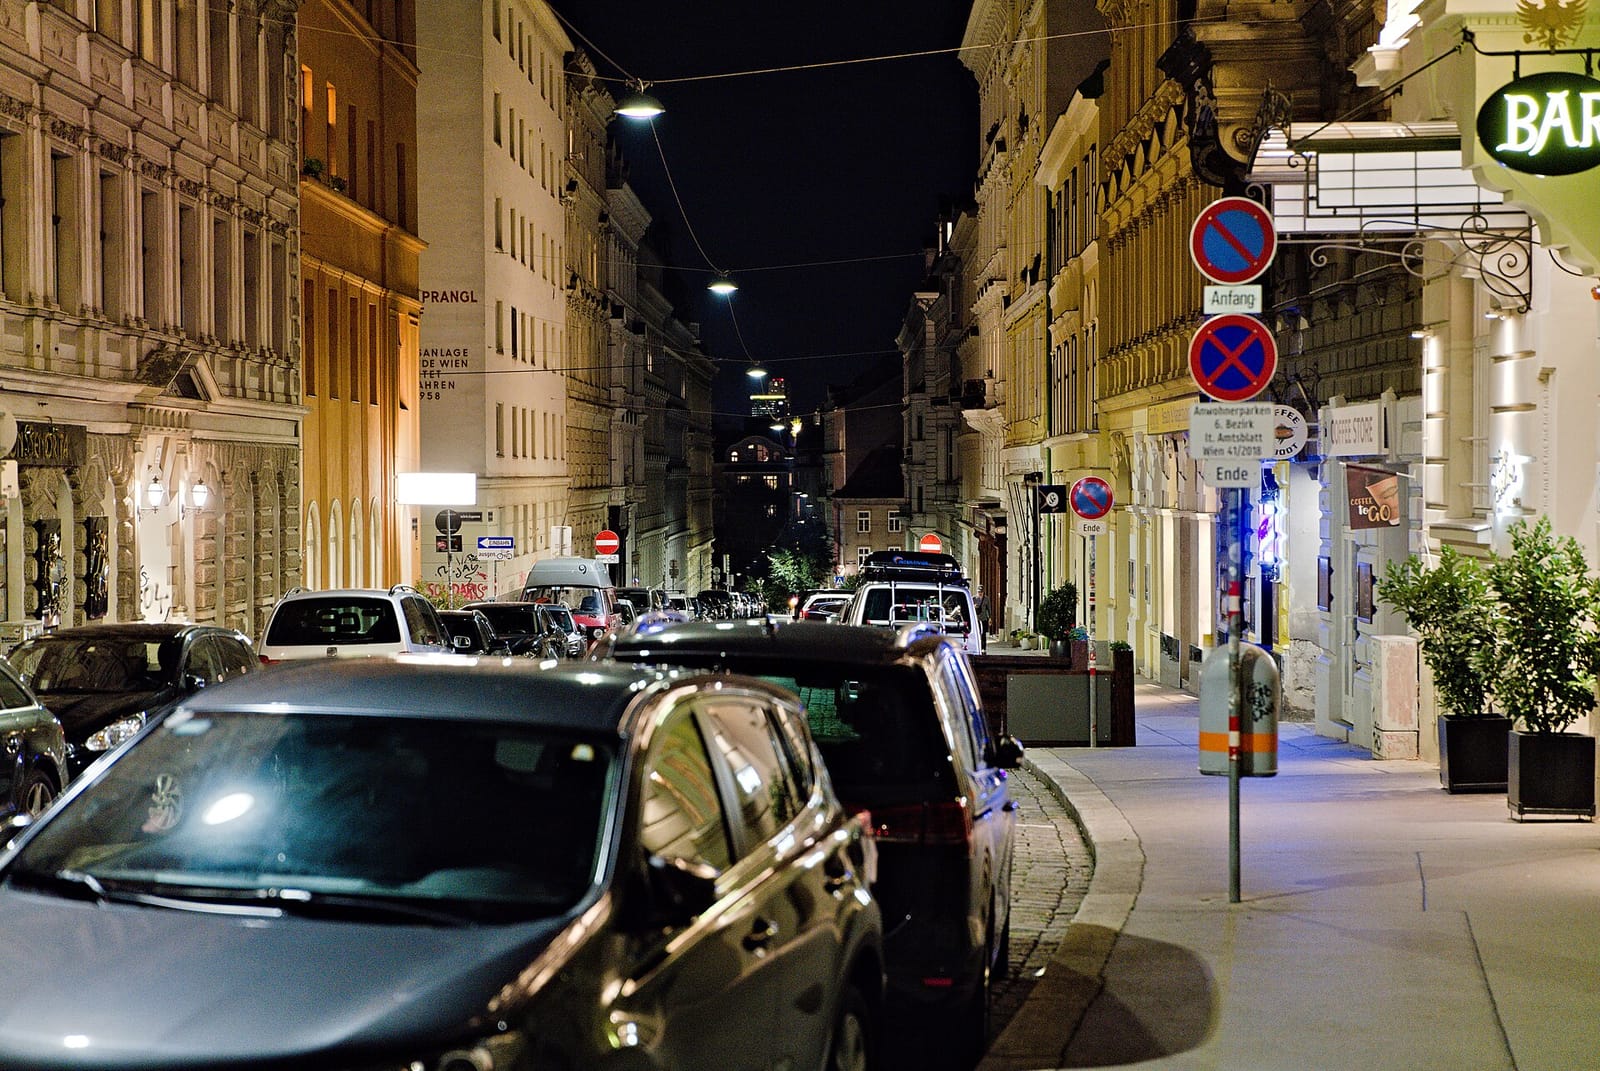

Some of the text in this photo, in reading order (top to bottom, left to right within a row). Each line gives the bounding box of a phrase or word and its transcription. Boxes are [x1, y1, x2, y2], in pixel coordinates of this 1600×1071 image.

[1495, 90, 1600, 156] BAR
[422, 290, 478, 303] PRANGL
[1211, 290, 1255, 309] Anfang
[440, 359, 468, 368] WIEN
[1194, 406, 1271, 417] Anwohnerparken
[1215, 419, 1254, 429] 6. Bezirk
[1218, 432, 1263, 442] Amtsblatt
[1203, 446, 1262, 456] Wien 41/2018
[1216, 466, 1249, 481] Ende
[1350, 497, 1374, 506] COFFEE
[1368, 504, 1391, 522] GO
